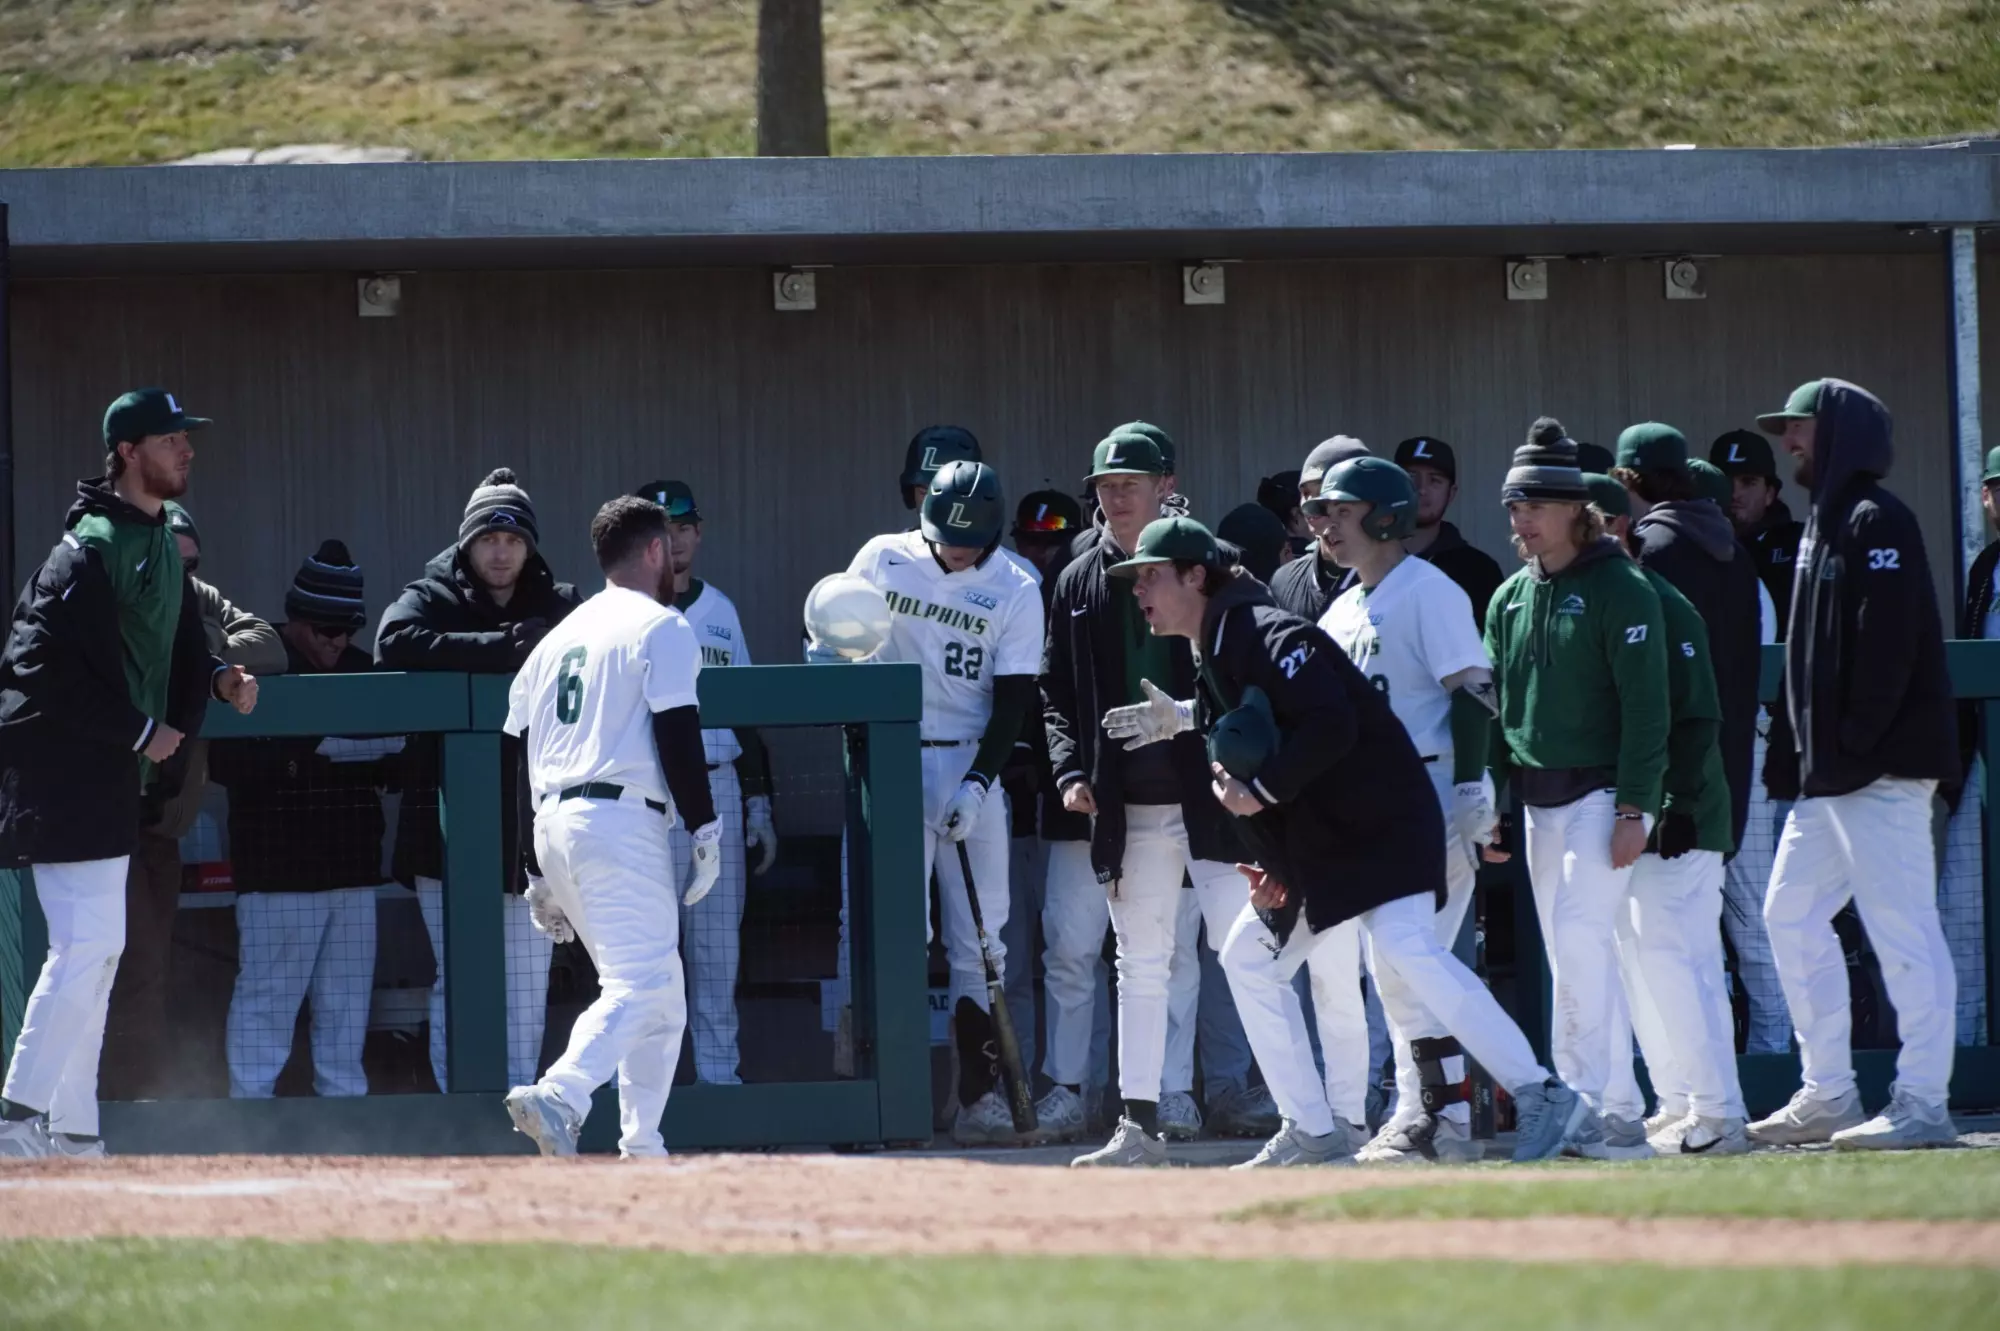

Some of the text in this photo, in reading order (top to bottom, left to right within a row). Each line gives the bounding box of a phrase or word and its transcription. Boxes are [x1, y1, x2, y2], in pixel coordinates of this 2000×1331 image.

[165, 392, 182, 414] L
[921, 447, 945, 471] L
[1105, 443, 1127, 464] L
[1414, 440, 1434, 458] L
[1728, 443, 1746, 462] L
[946, 502, 972, 528] L
[1868, 548, 1900, 570] 32
[885, 591, 989, 635] DOLPHINS
[1625, 624, 1648, 644] 27
[944, 641, 984, 681] 22
[1681, 642, 1696, 658] 5
[1280, 647, 1307, 680] 27
[556, 644, 588, 726] 6
